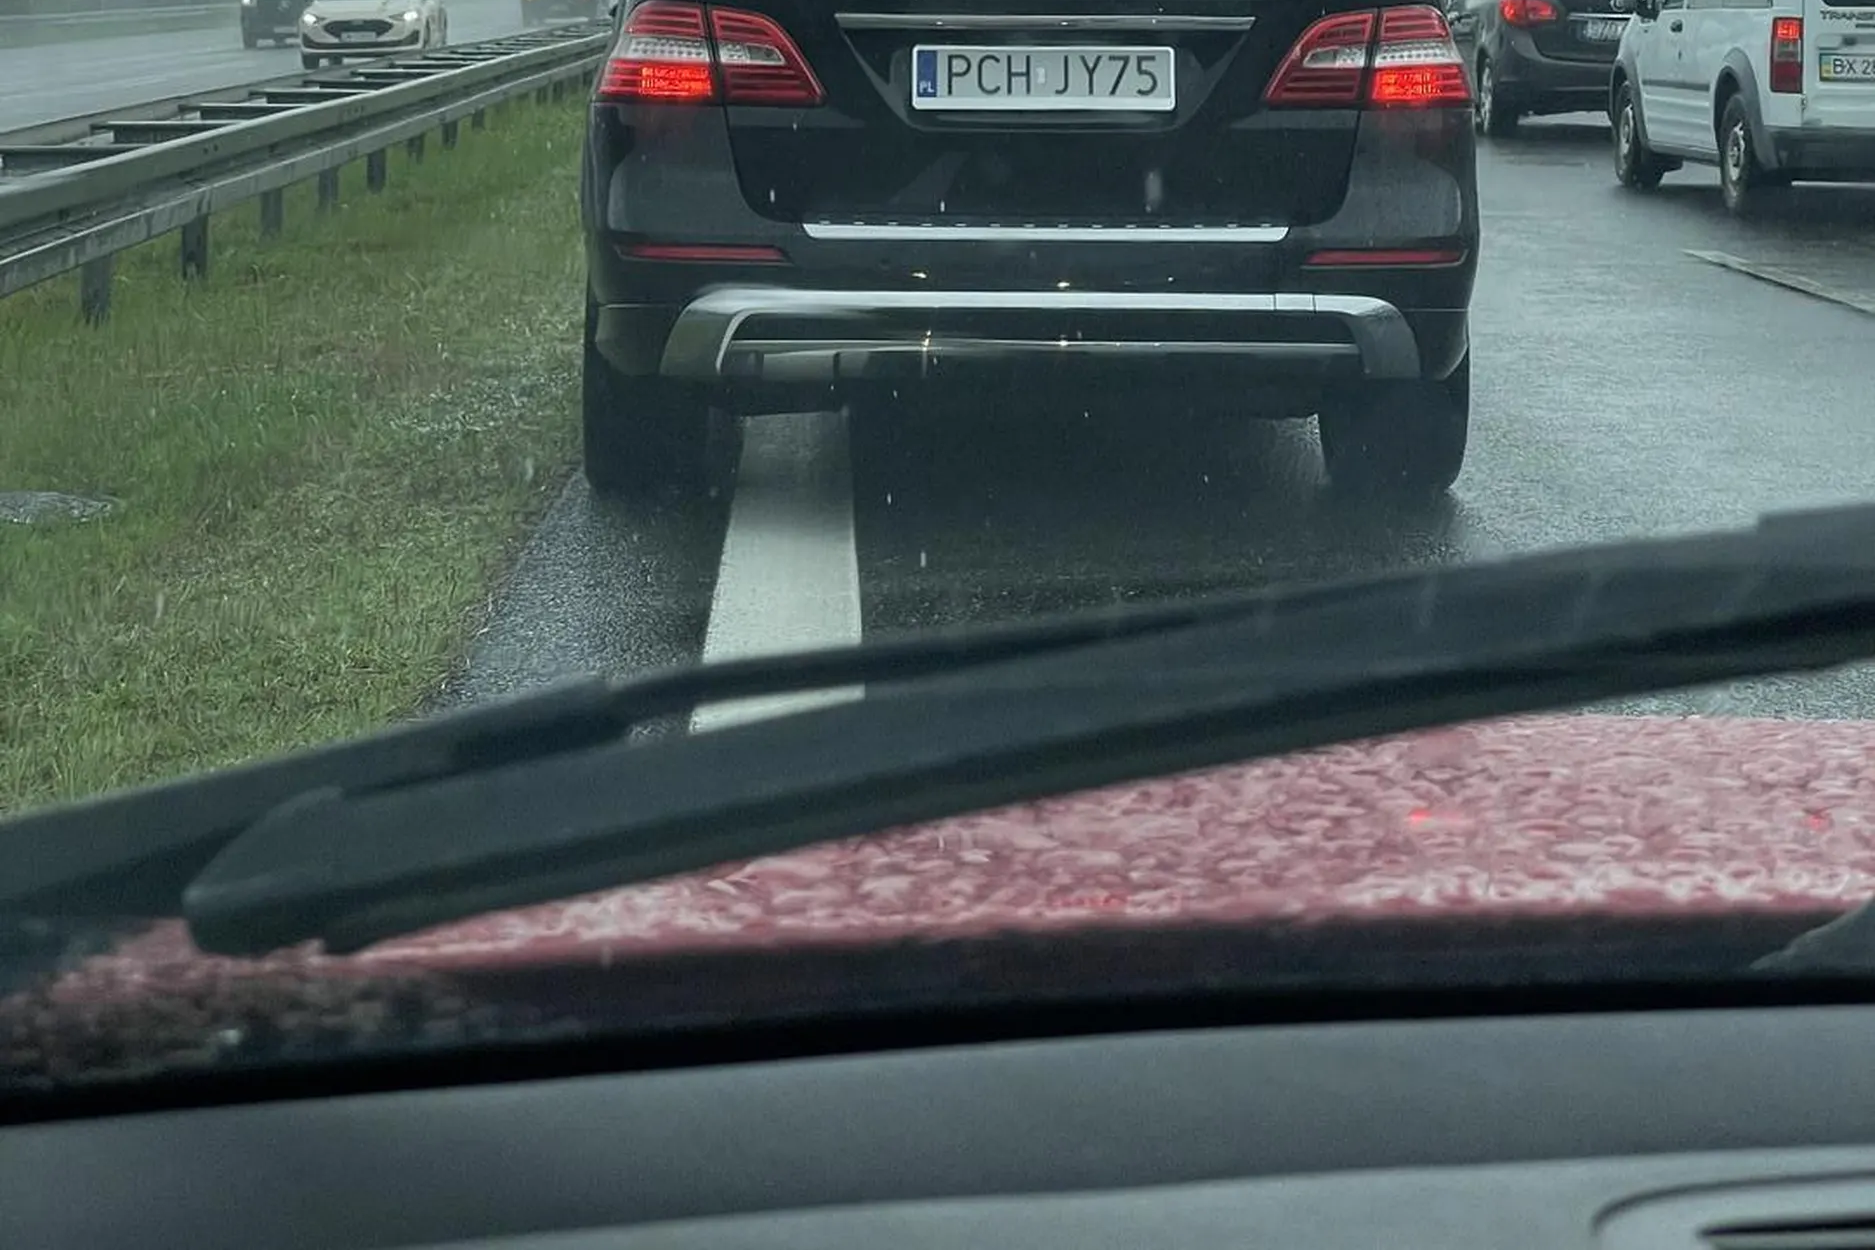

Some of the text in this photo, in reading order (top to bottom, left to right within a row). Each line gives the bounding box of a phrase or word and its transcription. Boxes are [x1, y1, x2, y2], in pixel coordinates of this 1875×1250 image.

[947, 54, 1159, 96] PCH JY75
[1833, 58, 1857, 75] BX
[919, 81, 935, 94] PL
